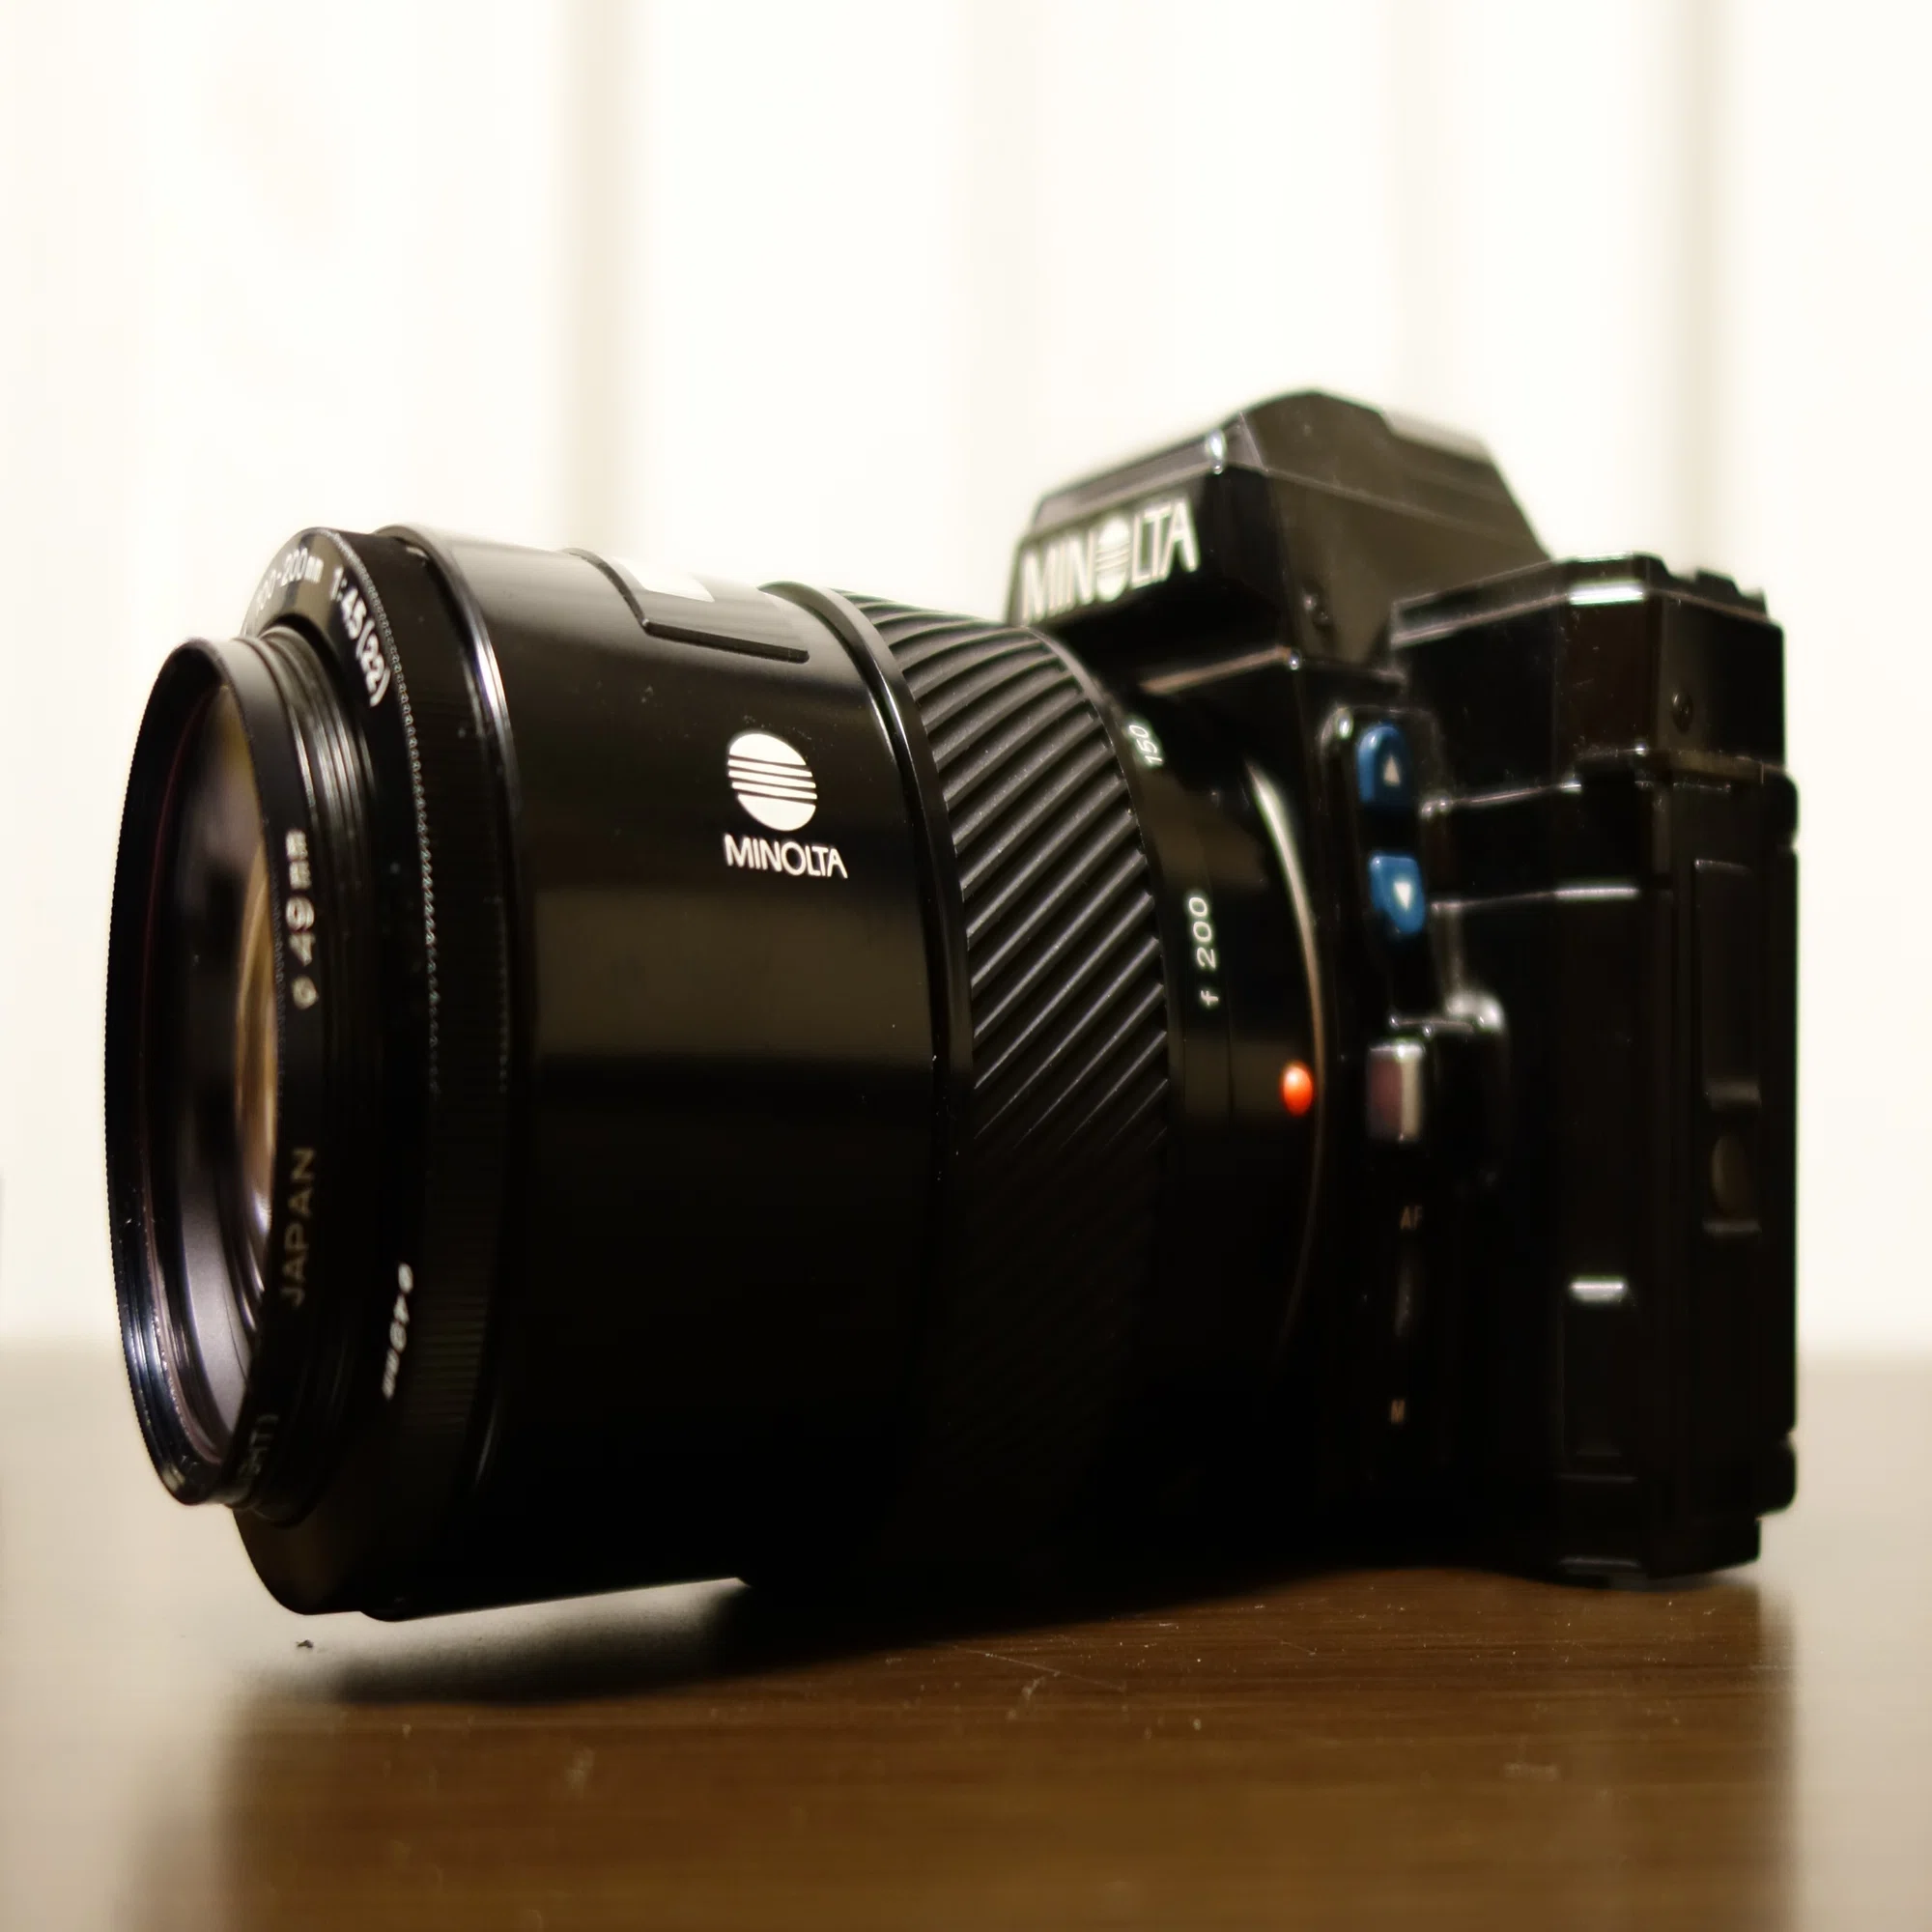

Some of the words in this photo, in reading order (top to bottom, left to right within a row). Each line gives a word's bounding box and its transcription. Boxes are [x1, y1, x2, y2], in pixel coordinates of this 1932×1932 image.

[1021, 496, 1200, 624] MINOLTA
[1128, 724, 1164, 766] 150
[724, 833, 849, 879] MINOLTA
[1188, 896, 1216, 970] 200
[280, 1147, 316, 1307] JAPAN
